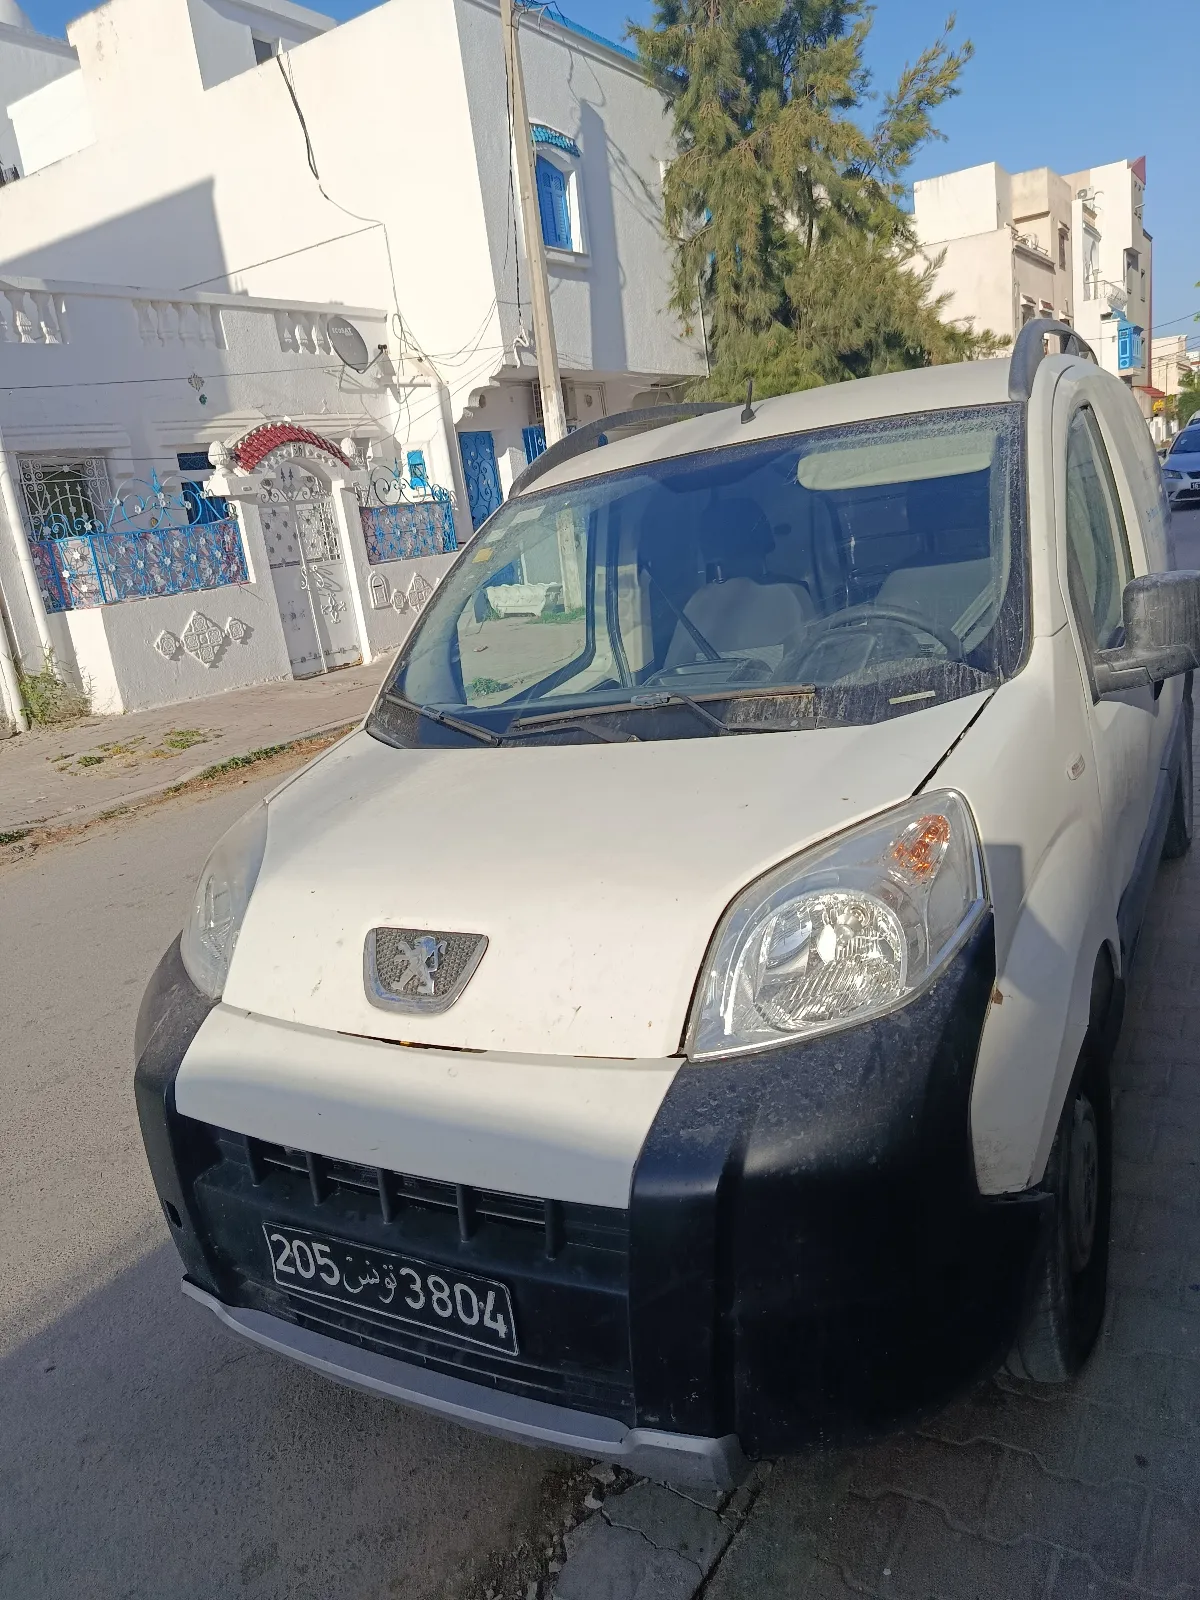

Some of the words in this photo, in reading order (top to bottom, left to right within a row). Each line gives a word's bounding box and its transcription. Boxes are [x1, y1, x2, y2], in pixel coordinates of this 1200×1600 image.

[270, 1234, 340, 1286] 205
[343, 1257, 397, 1304] تونس
[400, 1268, 508, 1339] 3804
